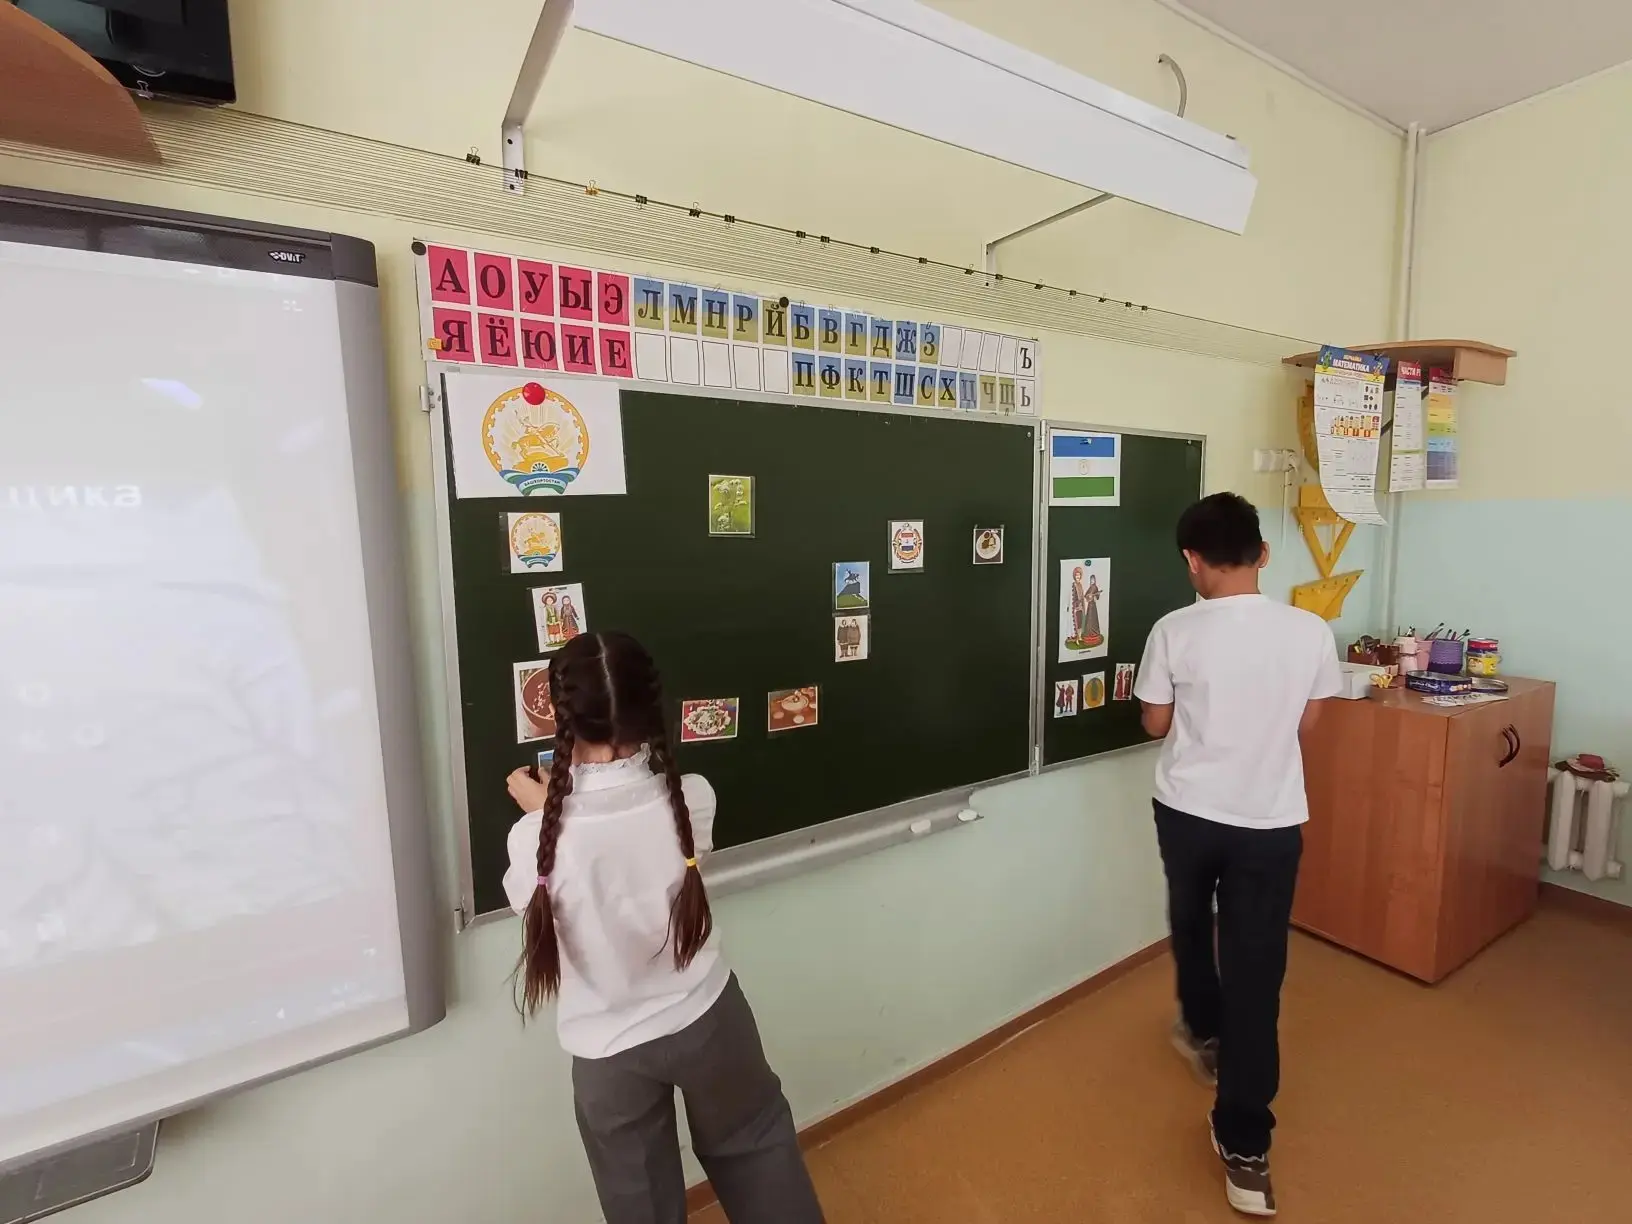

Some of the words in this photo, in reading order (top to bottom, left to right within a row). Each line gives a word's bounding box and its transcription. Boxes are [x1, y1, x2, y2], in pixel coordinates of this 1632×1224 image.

[436, 258, 466, 293] А
[480, 265, 506, 298] О
[522, 270, 549, 304] У
[559, 276, 592, 311] Ы
[604, 283, 623, 315] Э
[638, 289, 661, 320] Л
[672, 294, 698, 325] М
[705, 299, 726, 330] Н
[736, 304, 753, 332] Р
[765, 302, 785, 337] Й
[794, 313, 809, 340] Б
[823, 318, 838, 344] В
[849, 321, 863, 347] Г
[872, 325, 890, 357] Д
[896, 328, 916, 354] Ж
[923, 332, 935, 356] З
[1020, 347, 1032, 369] Ъ
[442, 320, 469, 353] Я
[486, 317, 511, 357] Ё
[521, 329, 557, 362] Ю
[565, 334, 592, 365] И
[606, 339, 627, 369] Е
[795, 361, 814, 388] П
[821, 365, 840, 389] Ф
[848, 367, 864, 393] К
[874, 370, 888, 395] Т
[894, 372, 915, 397] Ш
[921, 375, 933, 399] С
[940, 377, 955, 400] Х
[961, 380, 976, 408] Ц
[981, 382, 995, 404] Ч
[1000, 384, 1015, 408] Щ
[1020, 386, 1031, 407] Ь
[1333, 359, 1370, 372] МАТЕМАТИКА
